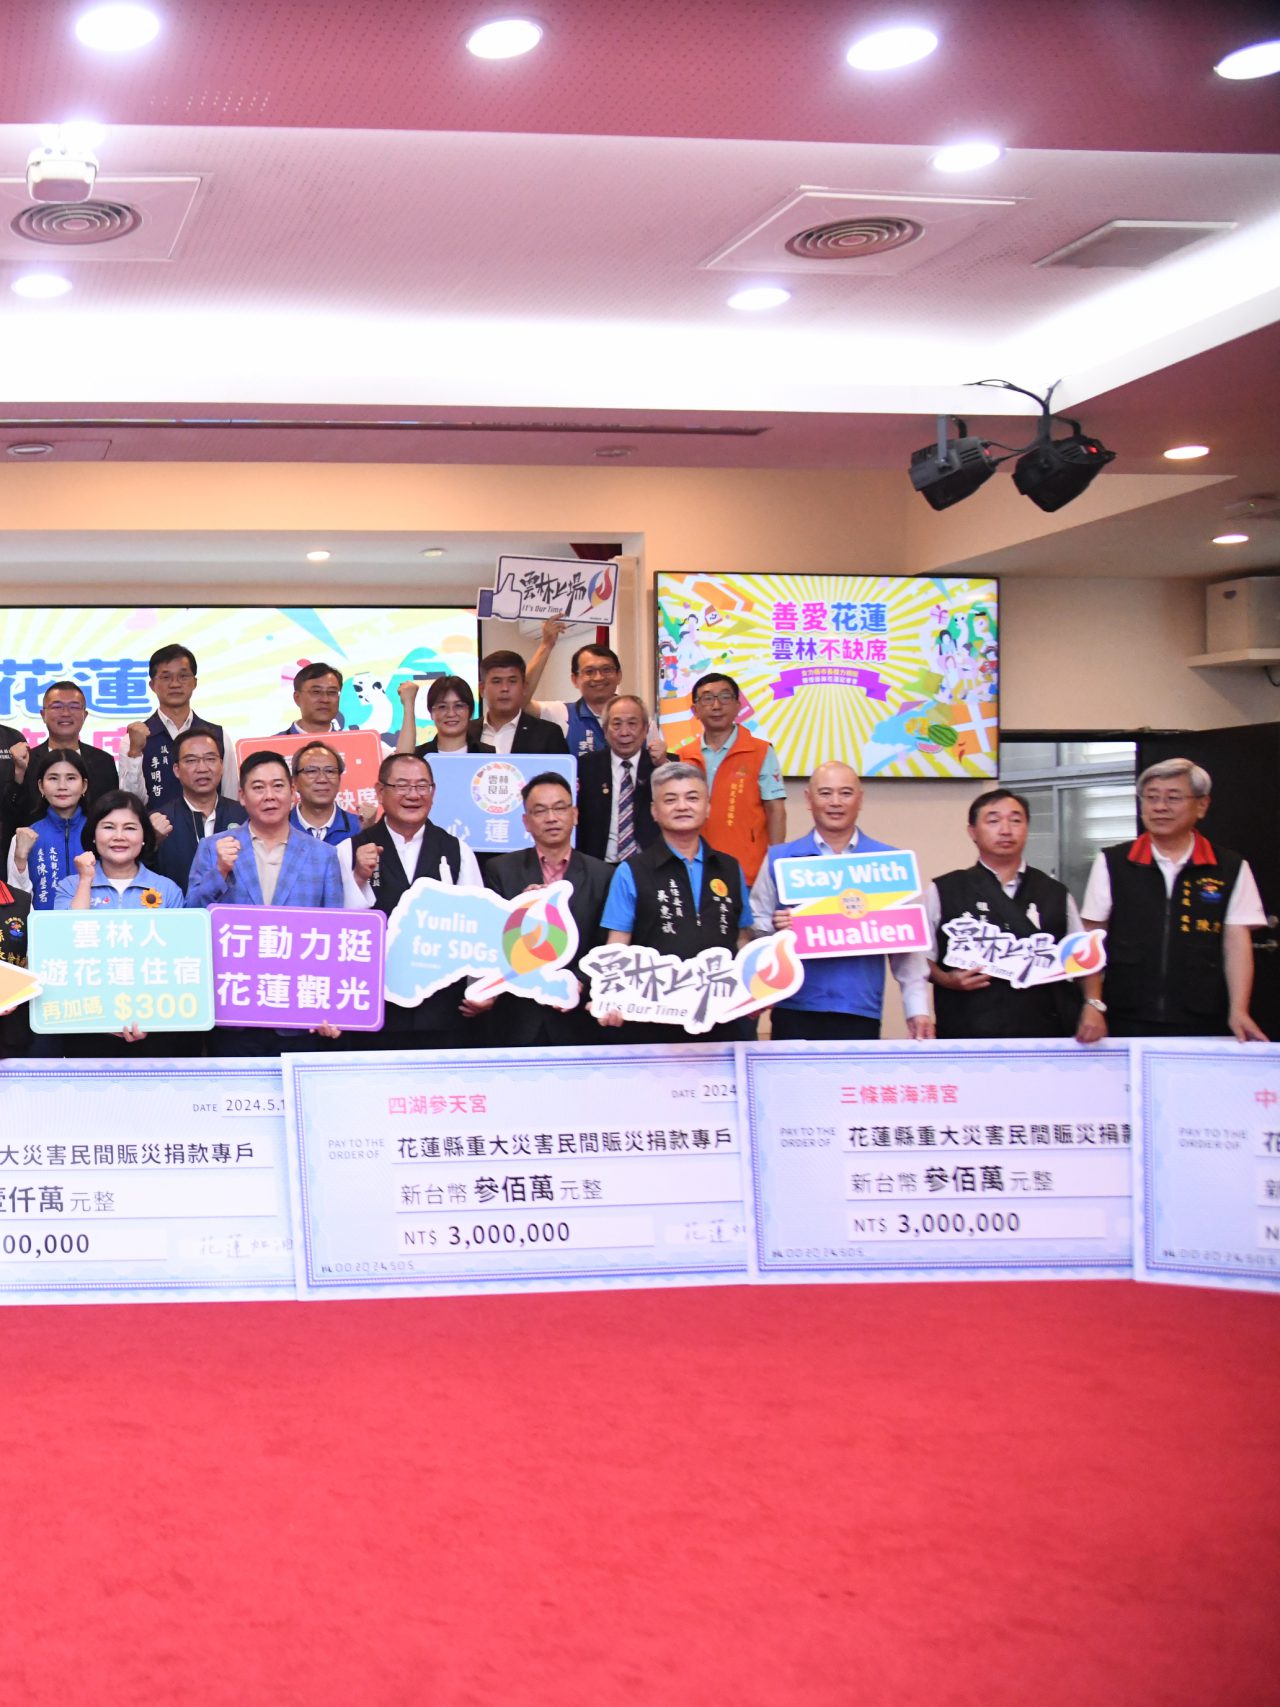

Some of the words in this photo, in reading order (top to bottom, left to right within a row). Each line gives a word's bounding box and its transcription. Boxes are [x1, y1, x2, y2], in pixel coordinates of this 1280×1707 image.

[520, 571, 586, 617] 雲林上場
[772, 602, 887, 631] 善愛花蓮
[772, 637, 887, 661] 雲林不缺席
[789, 867, 843, 890] Stay
[848, 861, 908, 884] With
[72, 920, 167, 948] 雲林人
[415, 909, 478, 934] Yunlin
[805, 920, 915, 947] Hualien
[219, 923, 372, 963] 行動力挺
[412, 935, 442, 957] for
[448, 938, 498, 963] SDGs
[948, 921, 1055, 983] 雲林上場
[40, 956, 202, 987] 遊花蓮住宿
[218, 971, 371, 1012] 花蓮觀光
[588, 950, 738, 1024] 雲林上場
[42, 996, 104, 1020] 再加碼
[114, 993, 198, 1020] $300
[627, 1003, 652, 1013] Our
[656, 1004, 688, 1017] Time
[388, 1094, 487, 1115] 四湖參天宮
[672, 1089, 696, 1098] DATE
[193, 1103, 218, 1112] DATE
[328, 1140, 346, 1148] PAY
[350, 1139, 362, 1148] TO
[365, 1138, 385, 1147] THE
[397, 1128, 732, 1160] 花蓮縣重大災害民間賑災捐款專戶
[780, 1128, 798, 1136] PAY
[801, 1128, 814, 1136] TO
[817, 1127, 836, 1136] THE
[781, 1139, 816, 1148] ORDER
[819, 1139, 831, 1147] OF
[1179, 1128, 1200, 1137] PAY
[1204, 1128, 1220, 1137] TO
[329, 1151, 364, 1160] ORDER
[367, 1151, 380, 1159] OF
[404, 1230, 437, 1246] NT$
[448, 1222, 570, 1249] 3,000,000
[898, 1212, 1021, 1237] 3,000,000
